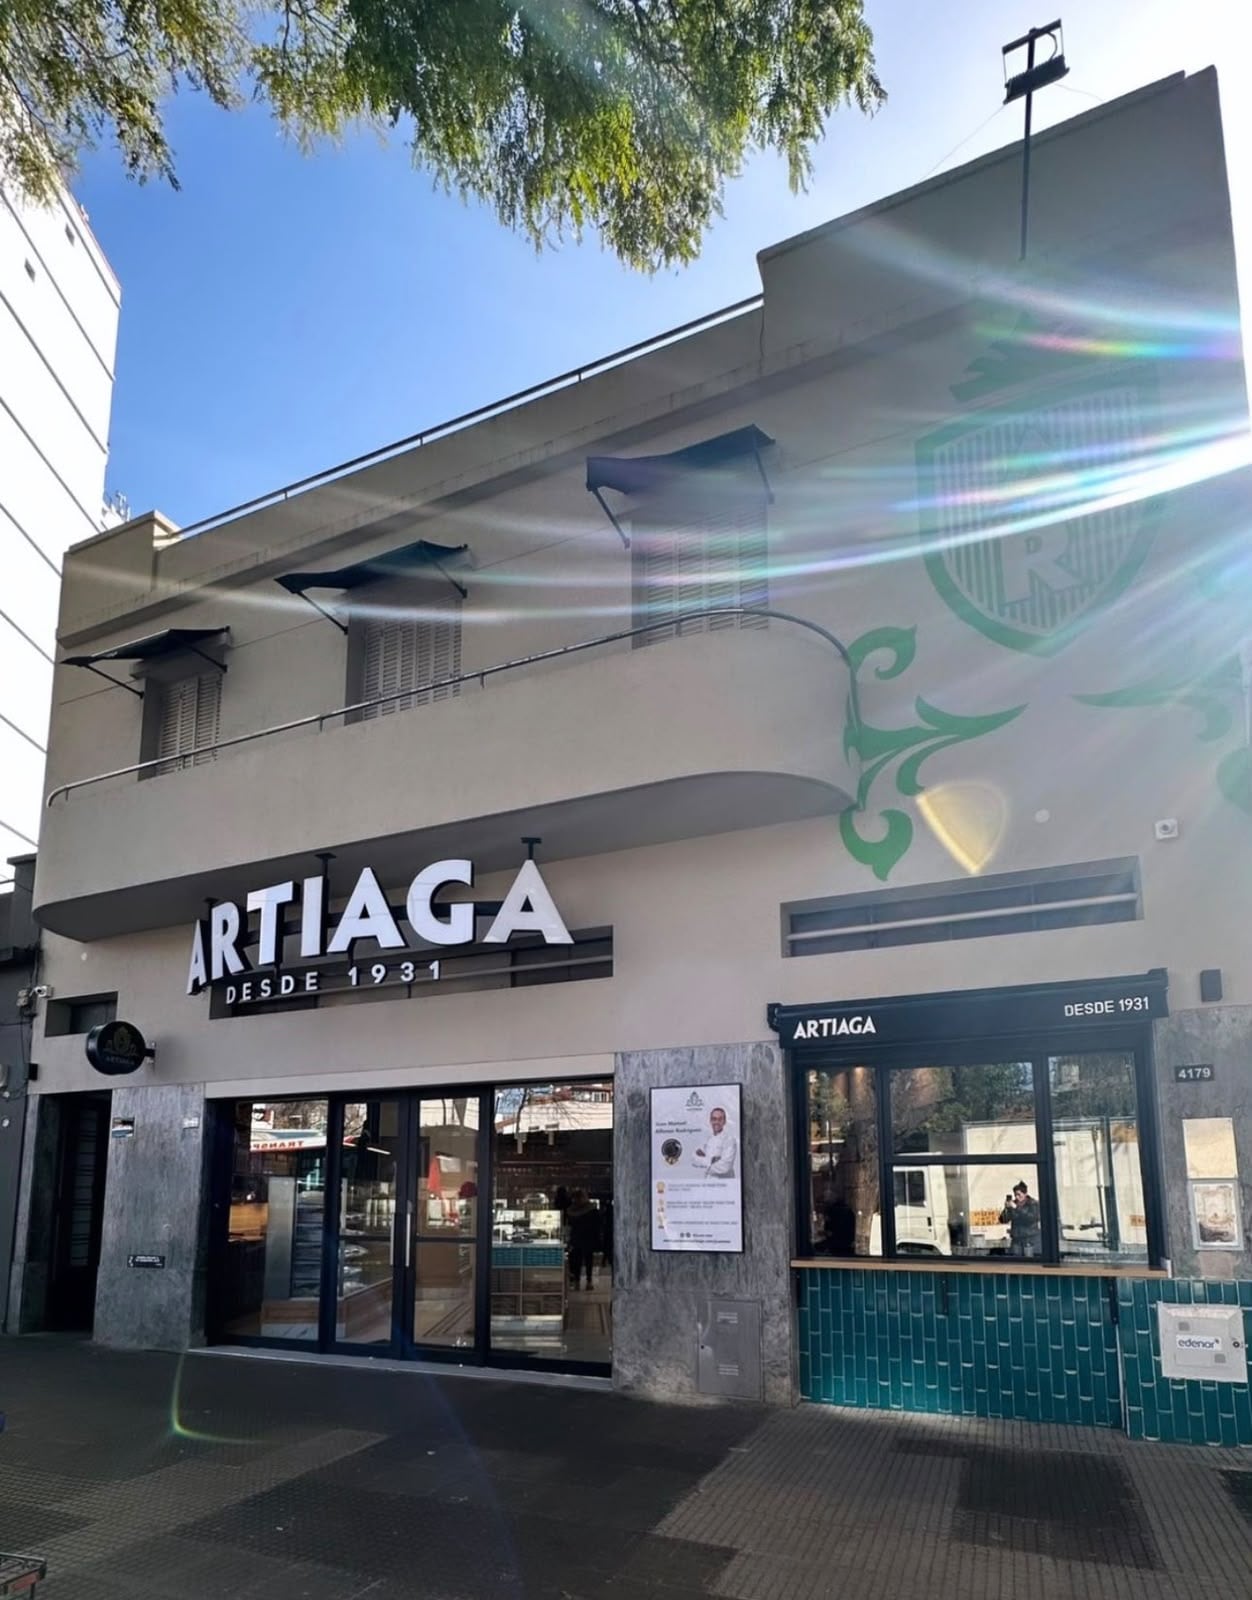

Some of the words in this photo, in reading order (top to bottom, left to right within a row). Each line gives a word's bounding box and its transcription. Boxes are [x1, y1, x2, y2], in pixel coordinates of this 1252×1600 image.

[186, 858, 575, 995] ARTIAGA
[226, 971, 318, 1004] DESDE
[348, 960, 440, 986] 1931
[1064, 1000, 1115, 1017] DESDE
[1118, 996, 1150, 1012] 1931
[793, 1016, 877, 1039] ARTIAGA
[1178, 1067, 1211, 1079] 4179
[1178, 1338, 1215, 1349] edenor
